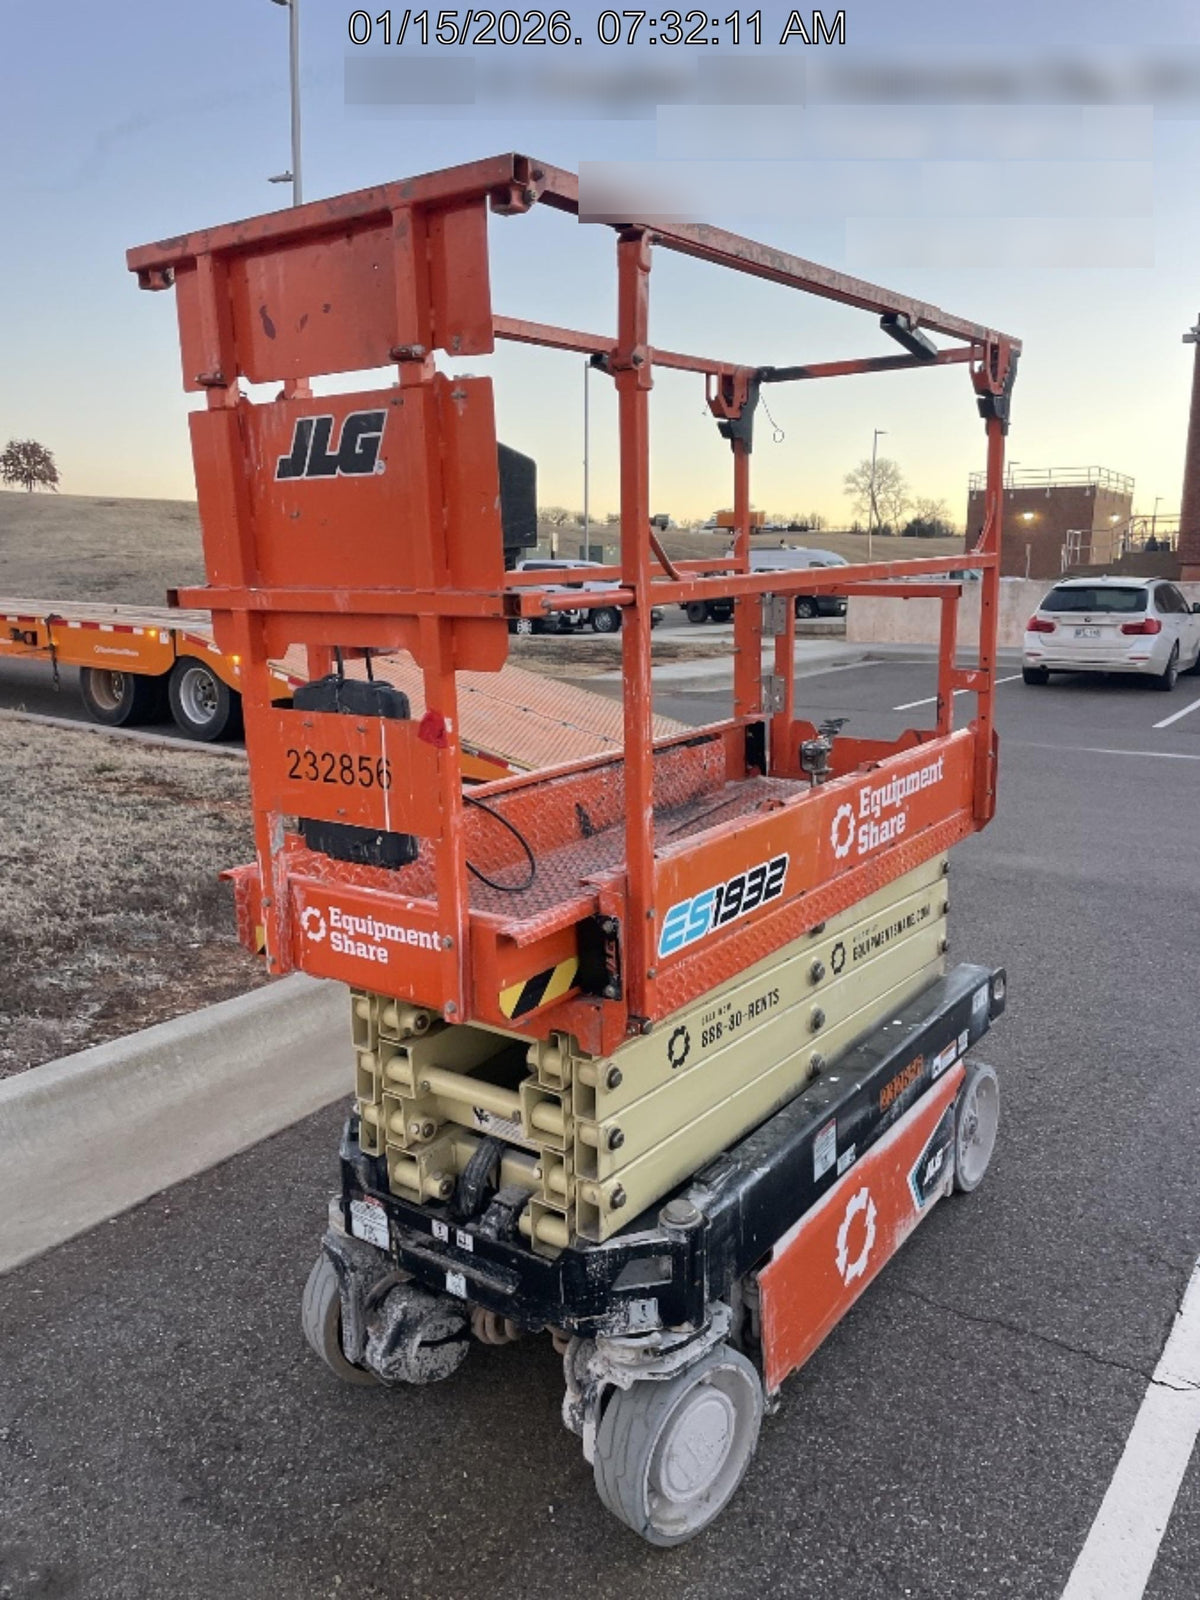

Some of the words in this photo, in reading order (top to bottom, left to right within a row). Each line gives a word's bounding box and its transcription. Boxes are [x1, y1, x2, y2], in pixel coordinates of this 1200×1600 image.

[274, 408, 388, 481] JLG
[286, 749, 393, 791] 232856
[860, 755, 944, 819] Equipment
[857, 811, 907, 855] Share
[328, 905, 442, 952] Equipment
[658, 852, 789, 958] ES1932
[330, 931, 389, 964] Share
